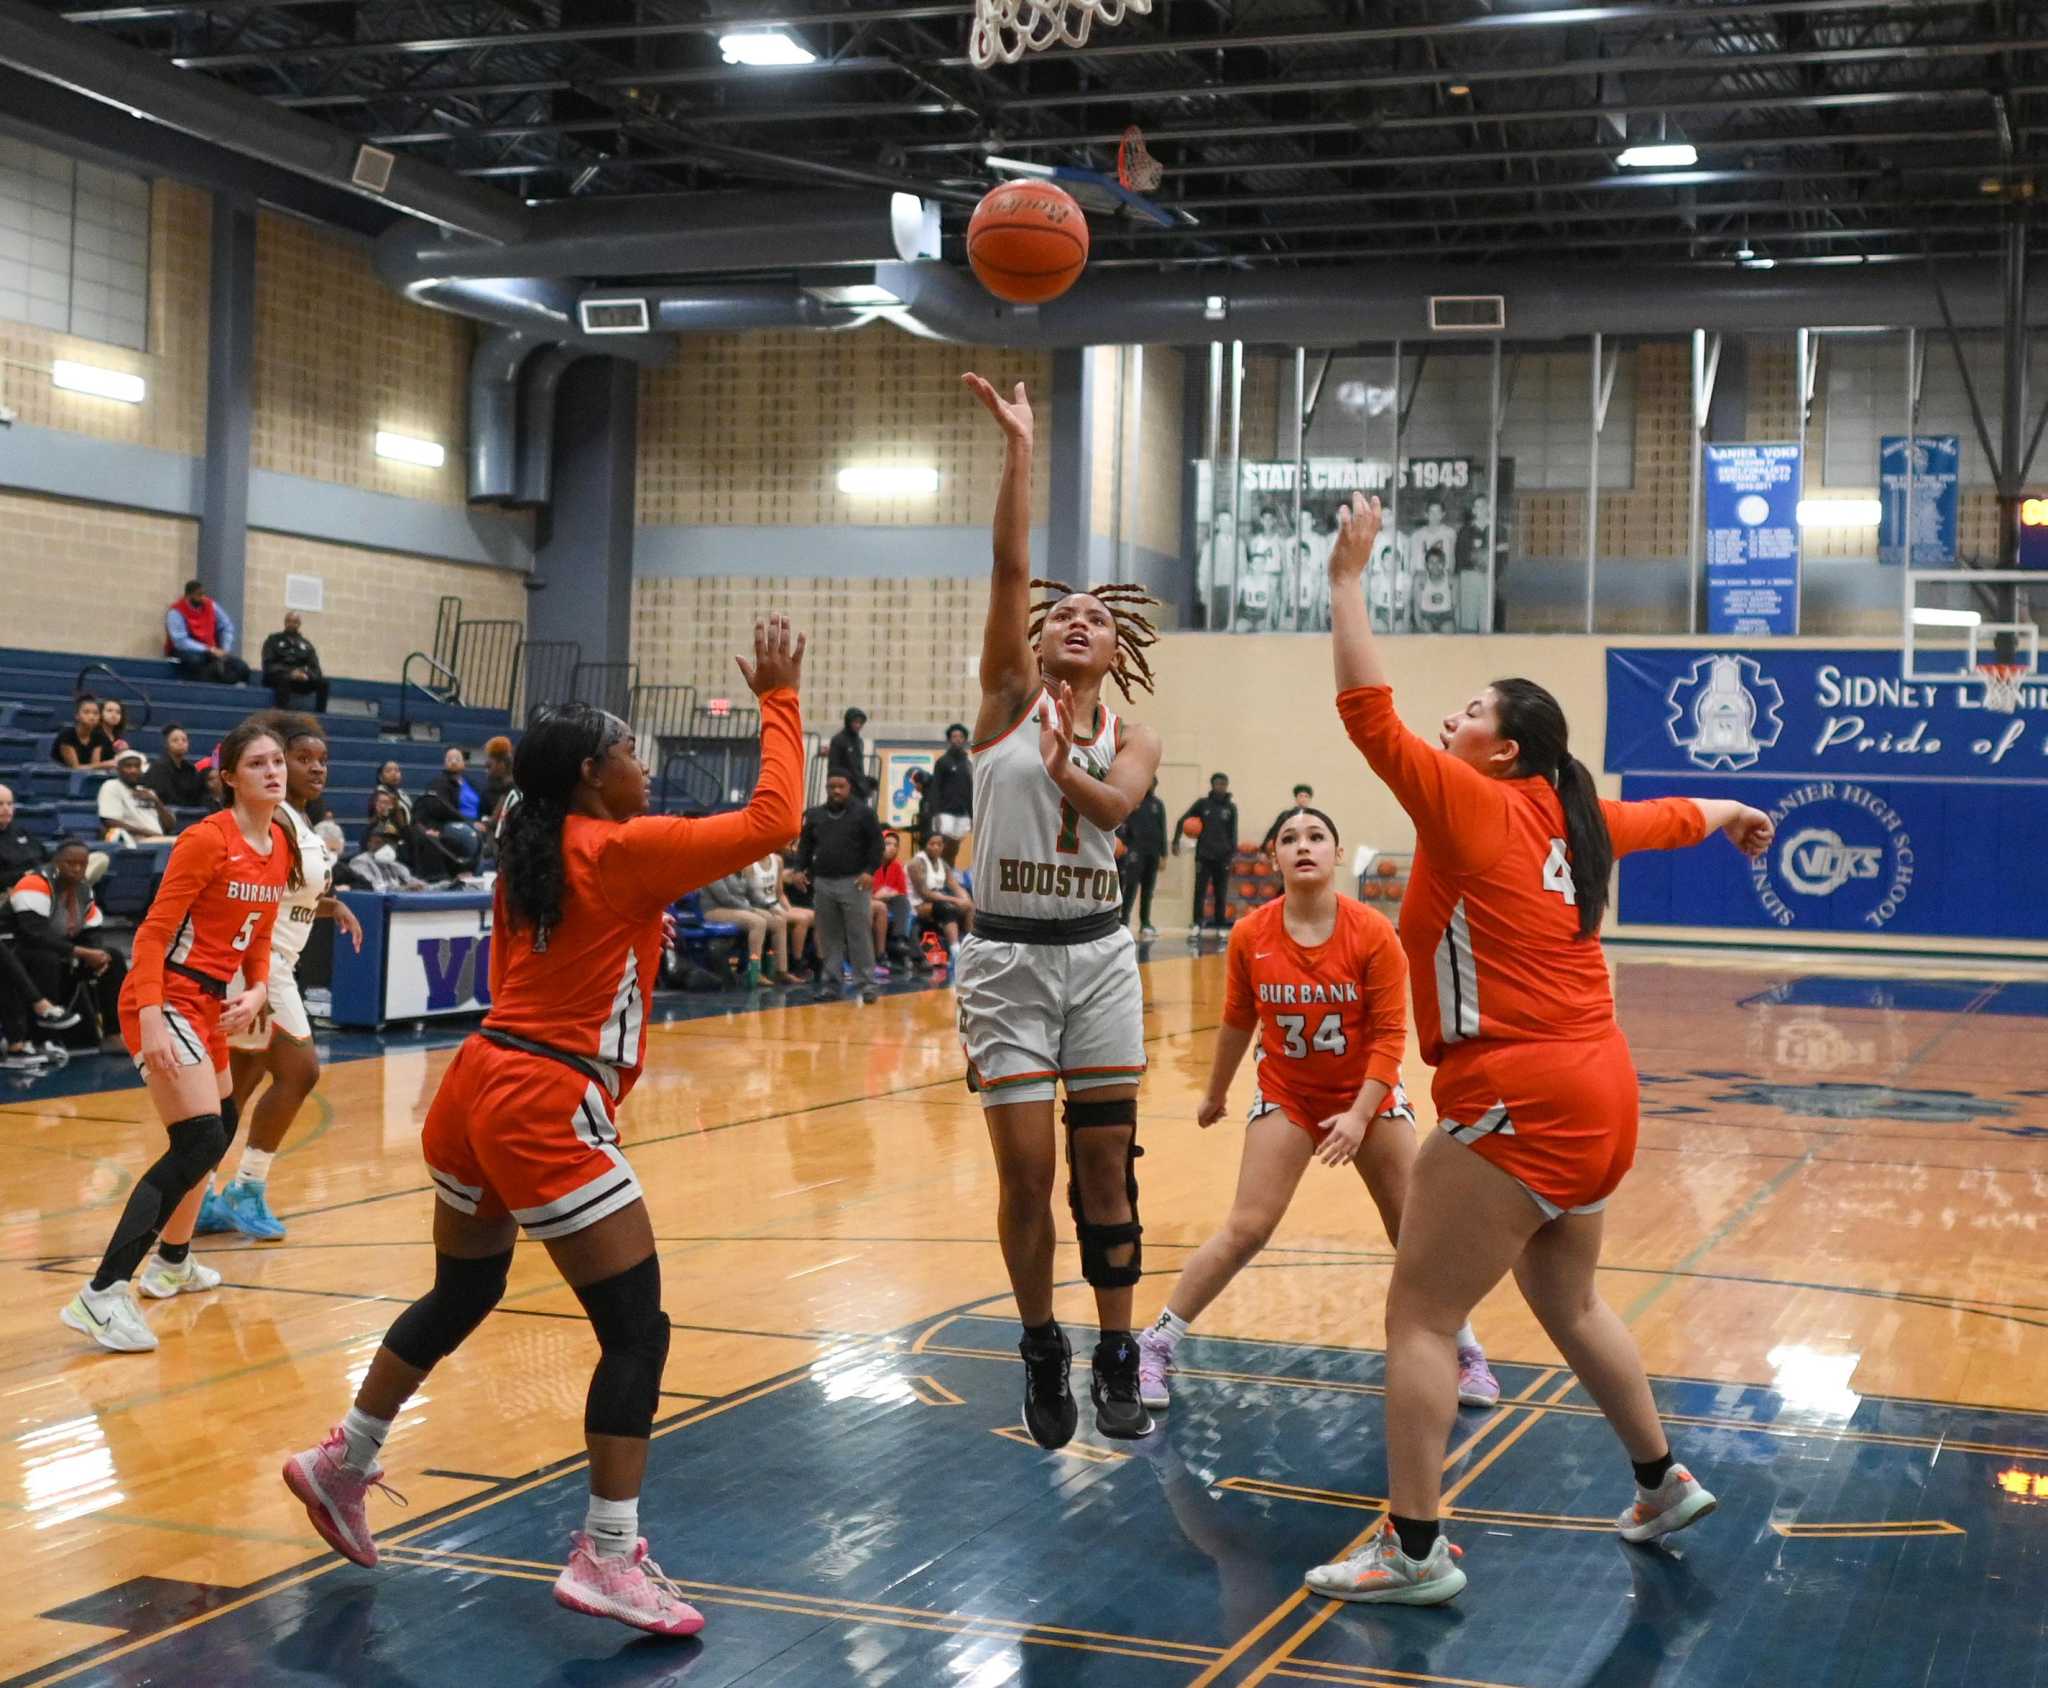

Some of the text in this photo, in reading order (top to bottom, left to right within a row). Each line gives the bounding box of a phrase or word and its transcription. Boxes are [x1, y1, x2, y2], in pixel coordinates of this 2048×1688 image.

[1412, 461, 1468, 488] 1943
[1814, 716, 1942, 755] Pride
[1973, 719, 2026, 764] of
[1842, 785, 1902, 832] HIGH
[999, 859, 1118, 902] HOUSTON
[1543, 838, 1576, 905] 4
[1864, 834, 1914, 927] SCHOOL
[231, 911, 262, 951] 5
[1260, 983, 1358, 1004] BURBANK
[1276, 1014, 1346, 1059] 34
